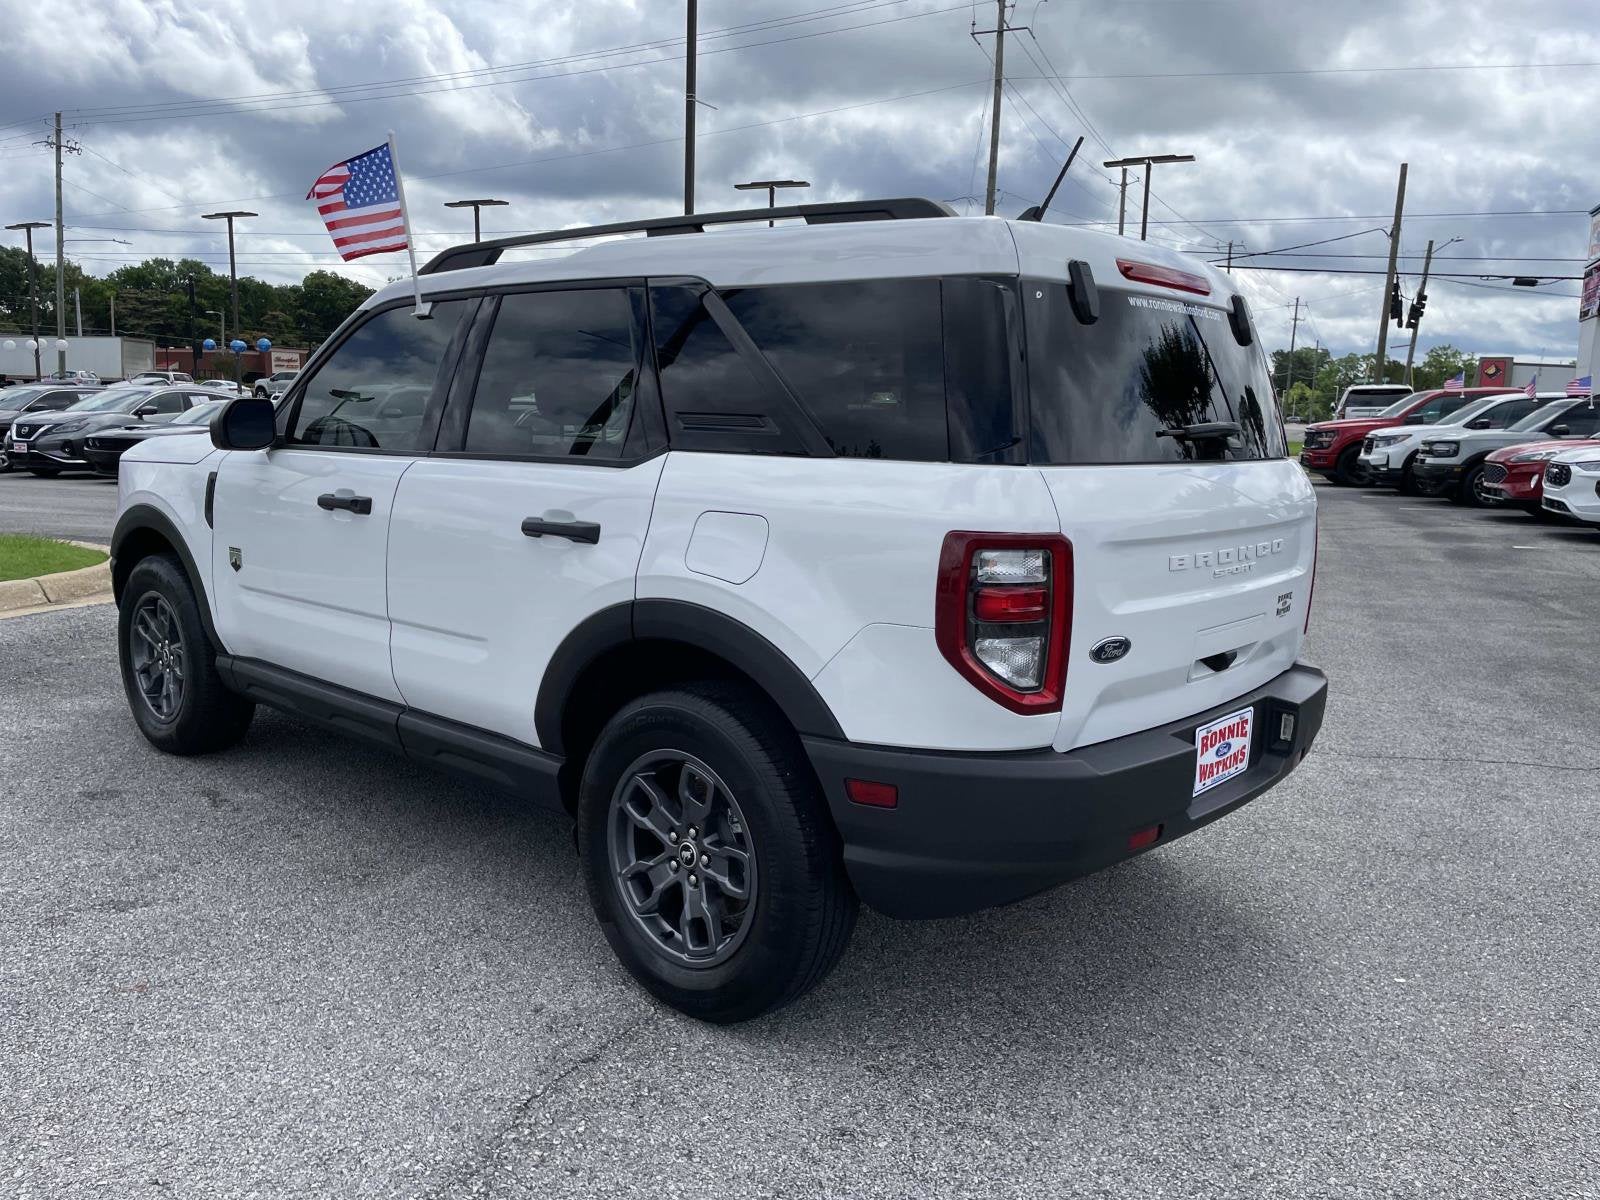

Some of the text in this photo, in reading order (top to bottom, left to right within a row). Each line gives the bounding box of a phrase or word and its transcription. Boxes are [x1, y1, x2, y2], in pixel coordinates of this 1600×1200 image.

[1168, 538, 1284, 571] BRONCO
[1213, 562, 1257, 578] SPORT
[1101, 642, 1125, 659] Ford
[1200, 718, 1249, 757] RONNIE
[1199, 744, 1247, 783] WATKINS
